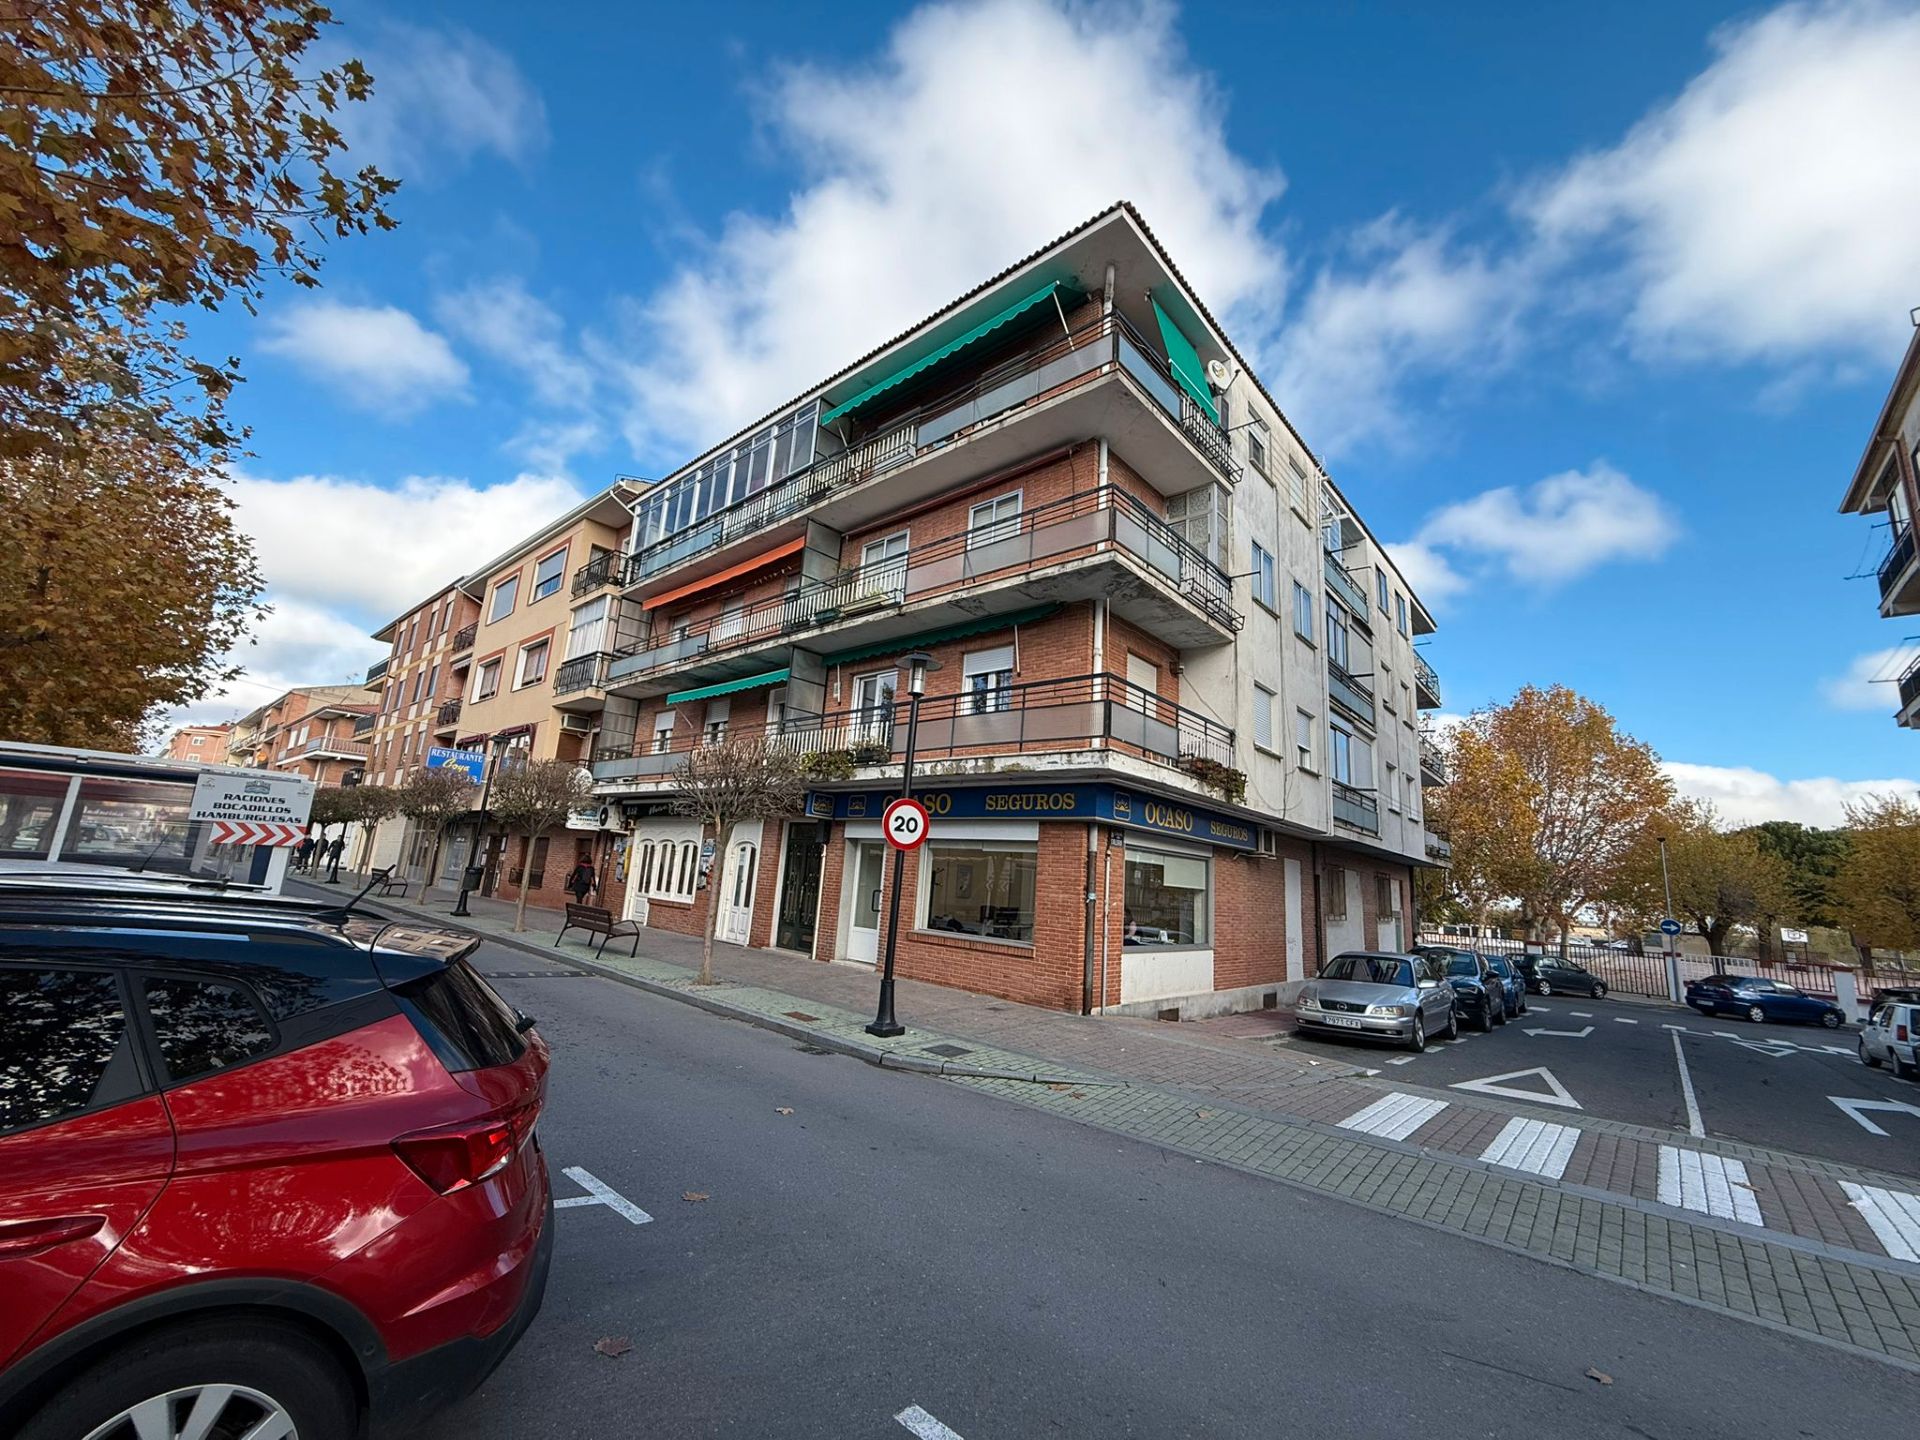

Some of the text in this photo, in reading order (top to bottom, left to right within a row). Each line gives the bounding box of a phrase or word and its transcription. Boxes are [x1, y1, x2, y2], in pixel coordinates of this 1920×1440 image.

[431, 748, 483, 763] RESTAURANTE
[223, 793, 286, 804] RACIONES
[985, 793, 1075, 810] SEGUROS
[213, 802, 291, 814] BOCADILLOS
[196, 811, 302, 824] HAMBURGUESAS
[894, 815, 918, 833] 20
[1145, 802, 1248, 842] OCASO SEGUROS
